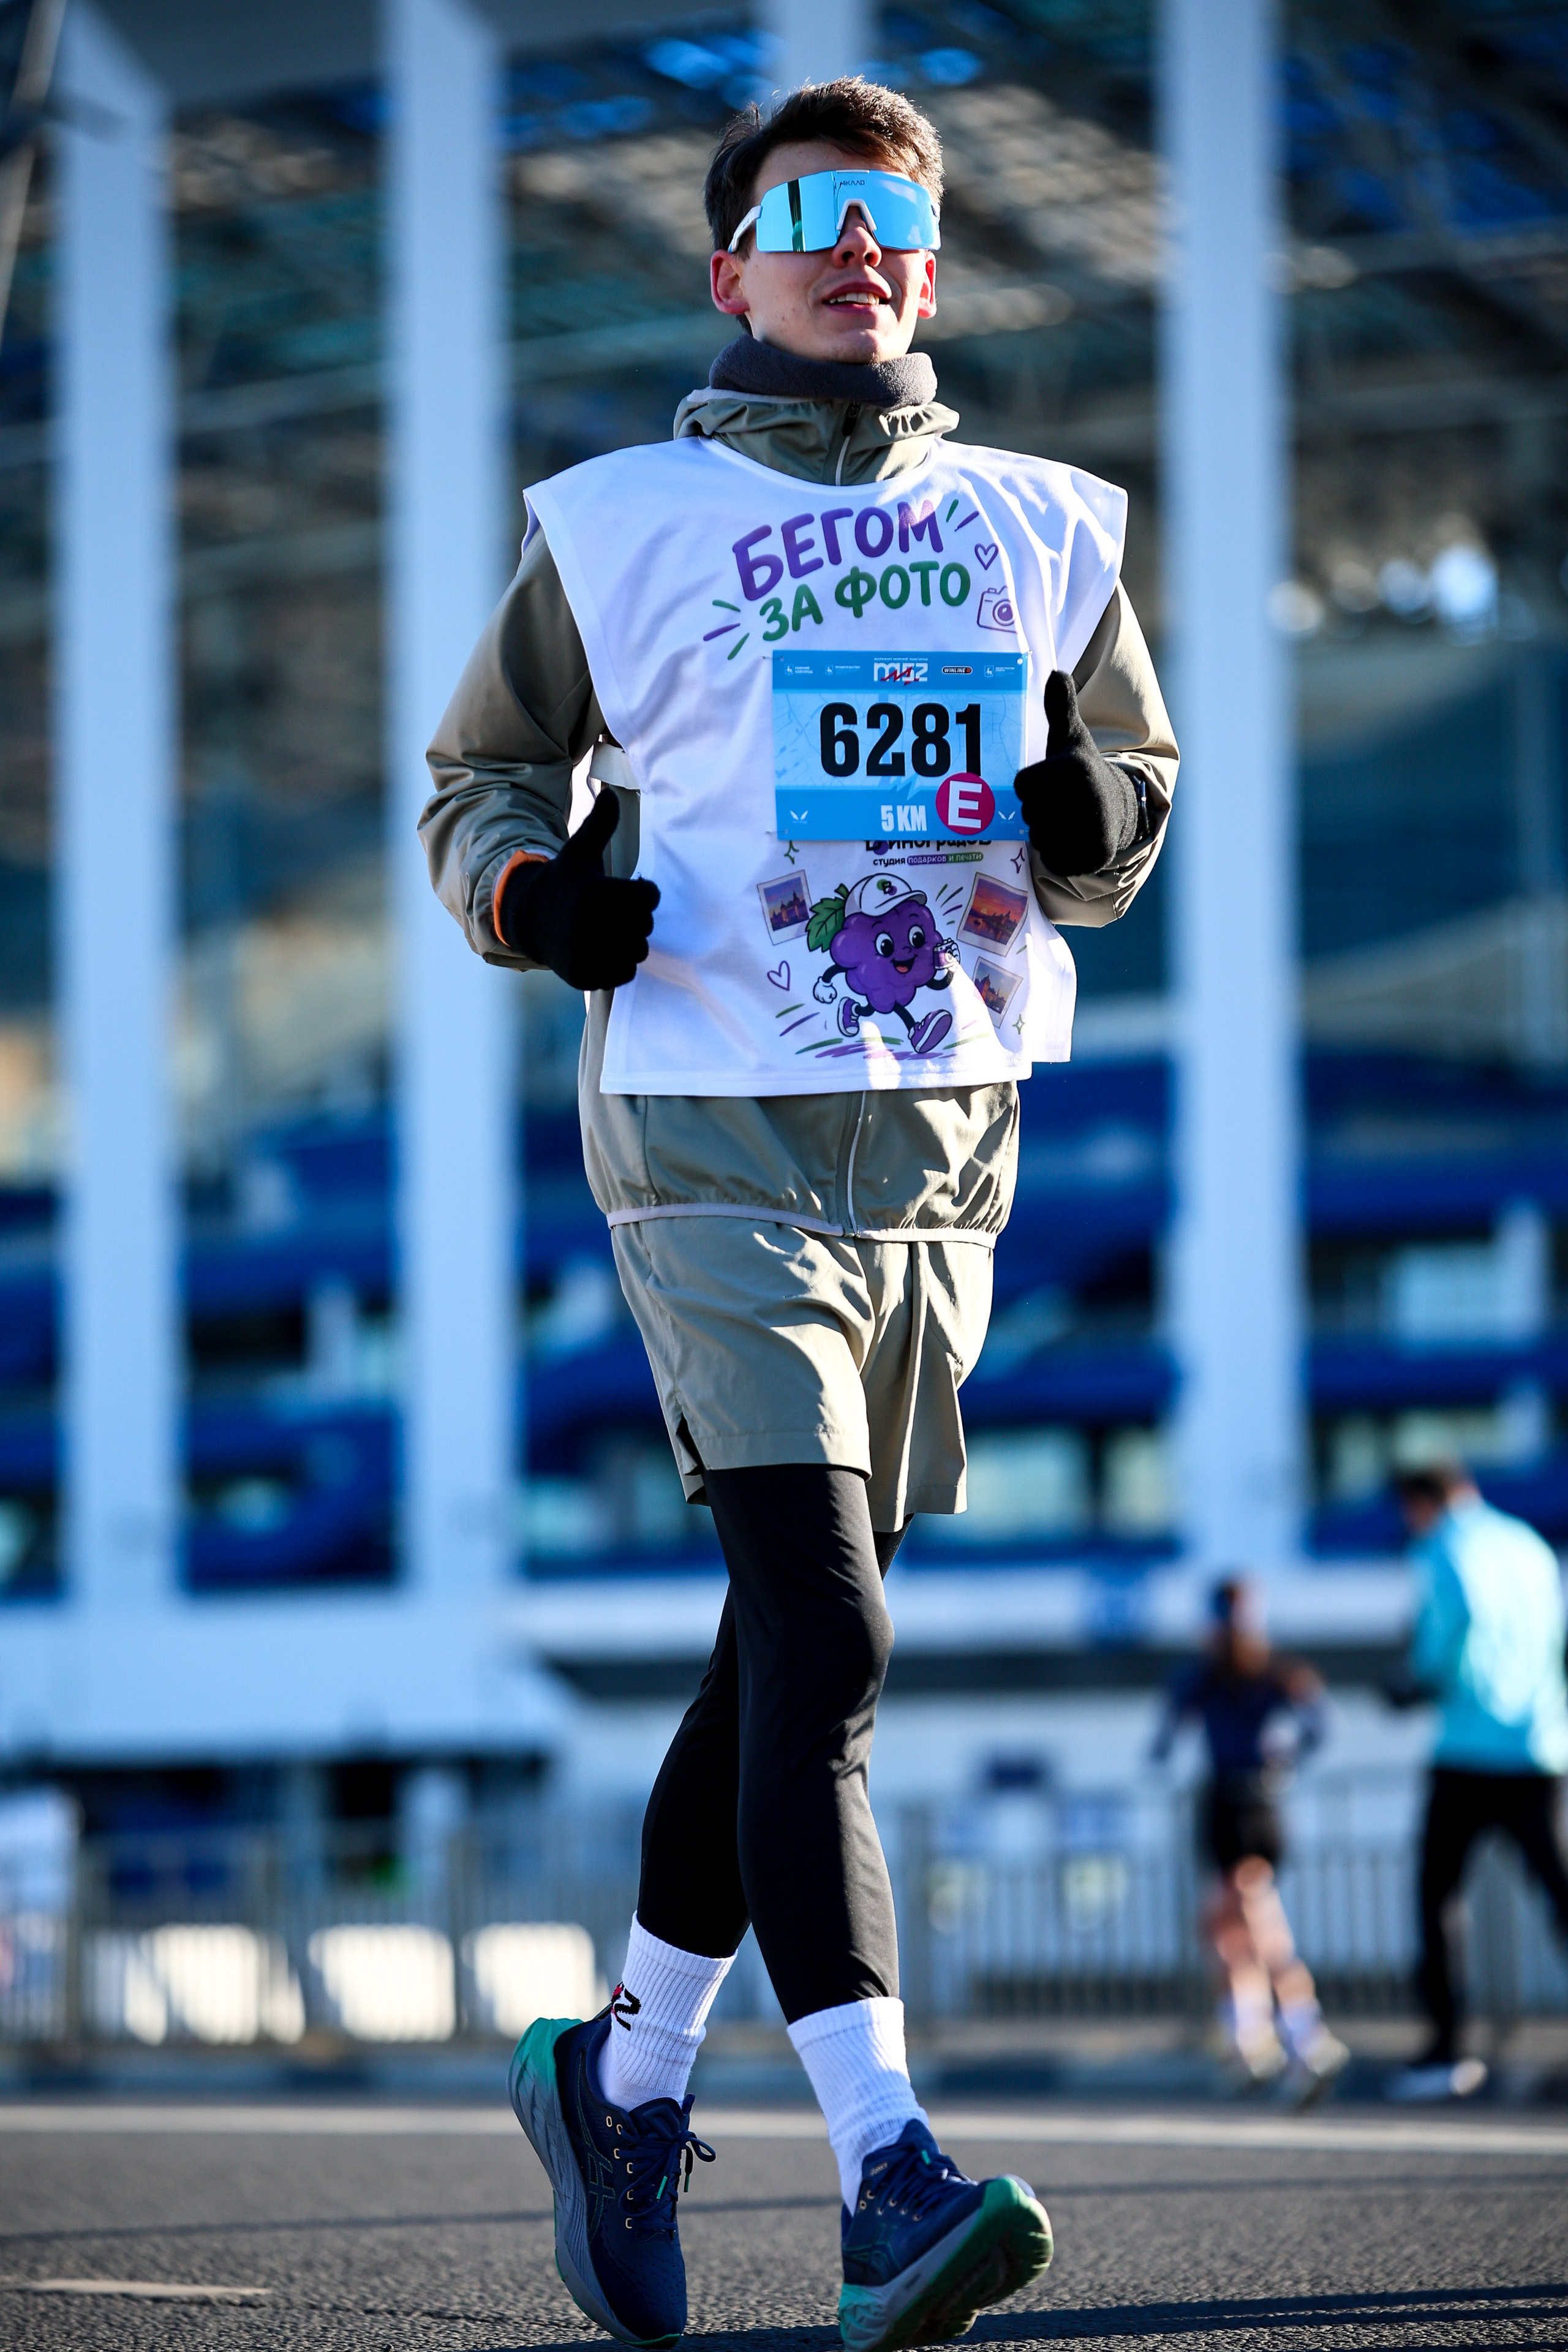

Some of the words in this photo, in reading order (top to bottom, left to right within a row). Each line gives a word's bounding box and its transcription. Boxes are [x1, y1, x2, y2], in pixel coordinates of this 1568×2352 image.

[732, 500, 944, 601] БЕГОМ
[760, 584, 824, 642] ЗА
[835, 560, 971, 618] ФОТО
[820, 702, 981, 777] 6281
[881, 805, 895, 832] 5
[897, 805, 927, 832] KM
[948, 780, 983, 829] E
[873, 858, 906, 867] студия
[908, 854, 947, 864] подарков
